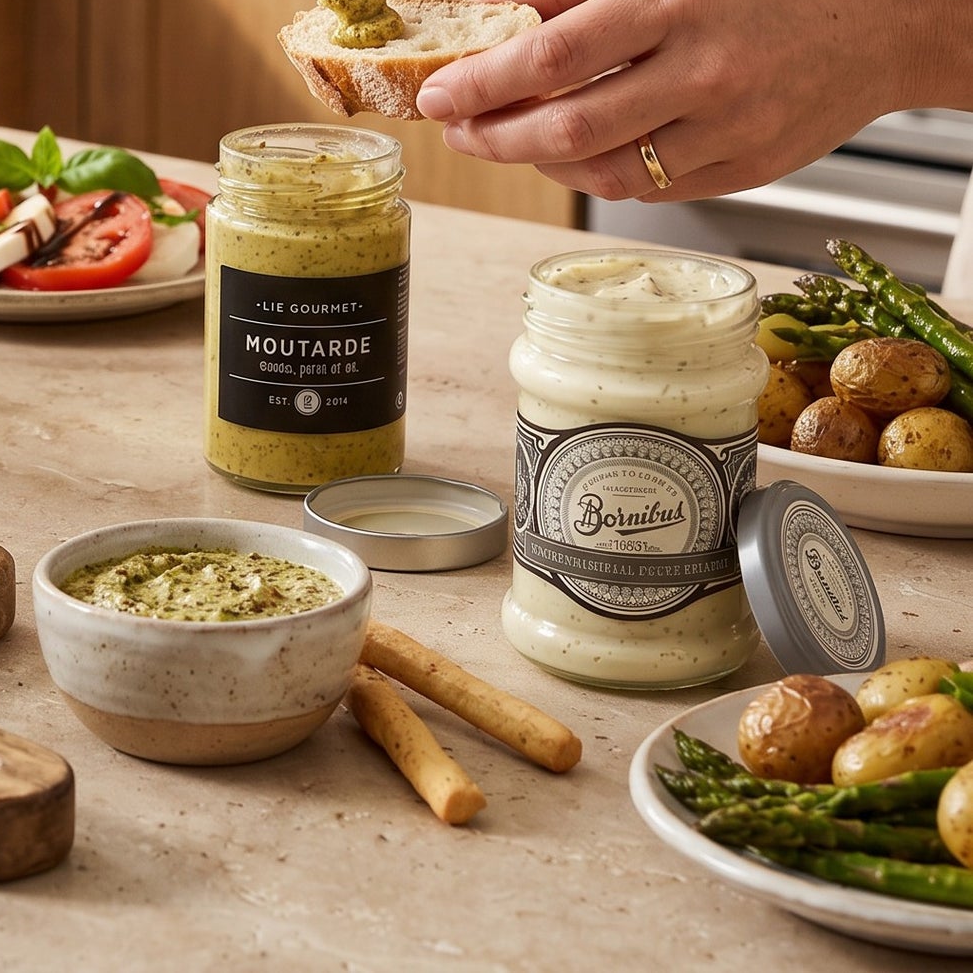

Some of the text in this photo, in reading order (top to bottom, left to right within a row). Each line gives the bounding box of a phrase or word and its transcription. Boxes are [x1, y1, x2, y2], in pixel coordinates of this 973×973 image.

[262, 301, 357, 314] LIE GOURMET
[246, 334, 371, 357] MOUTARDE
[269, 395, 347, 406] EST. 2014
